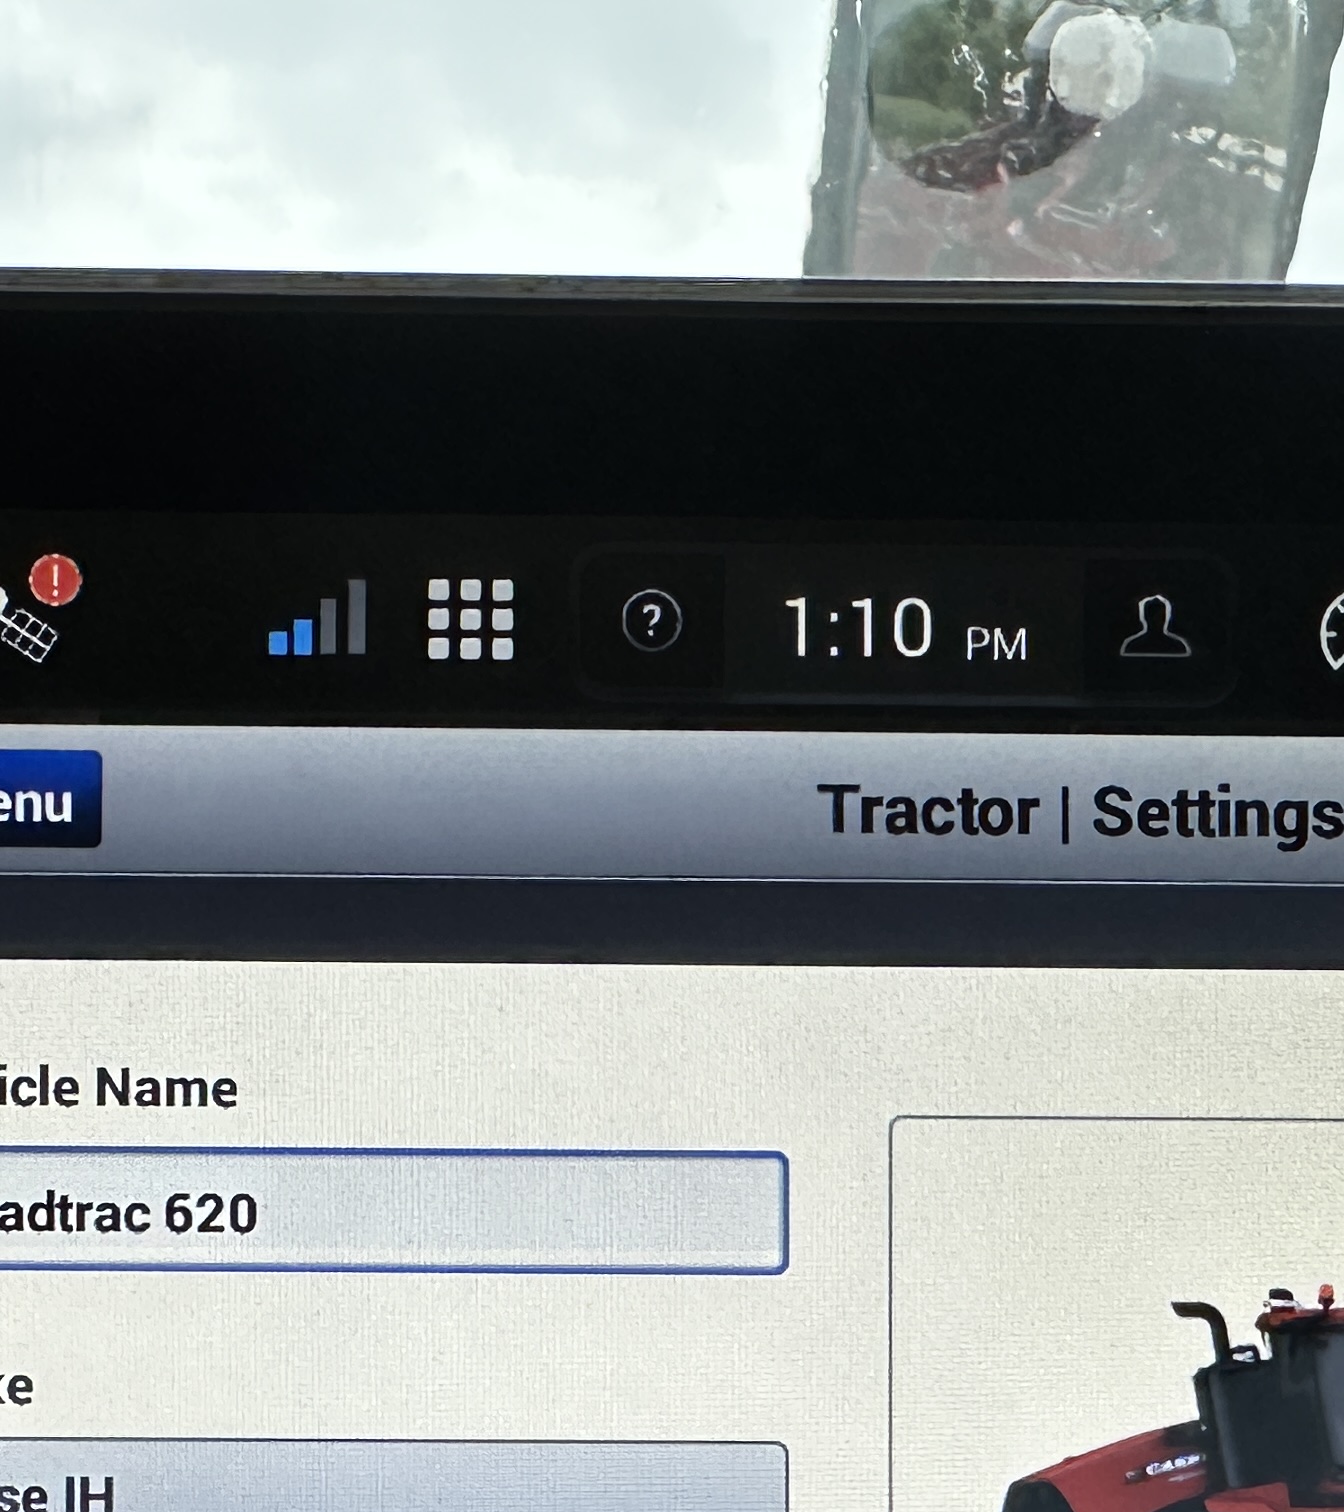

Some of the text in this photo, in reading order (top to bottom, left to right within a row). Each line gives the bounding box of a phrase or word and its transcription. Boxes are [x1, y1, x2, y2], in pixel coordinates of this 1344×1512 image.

[786, 597, 1026, 660] 1:10 PM
[817, 784, 1040, 836] Tractor
[1093, 784, 1344, 852] Settings
[97, 1067, 237, 1108] Name
[166, 1193, 257, 1235] 620
